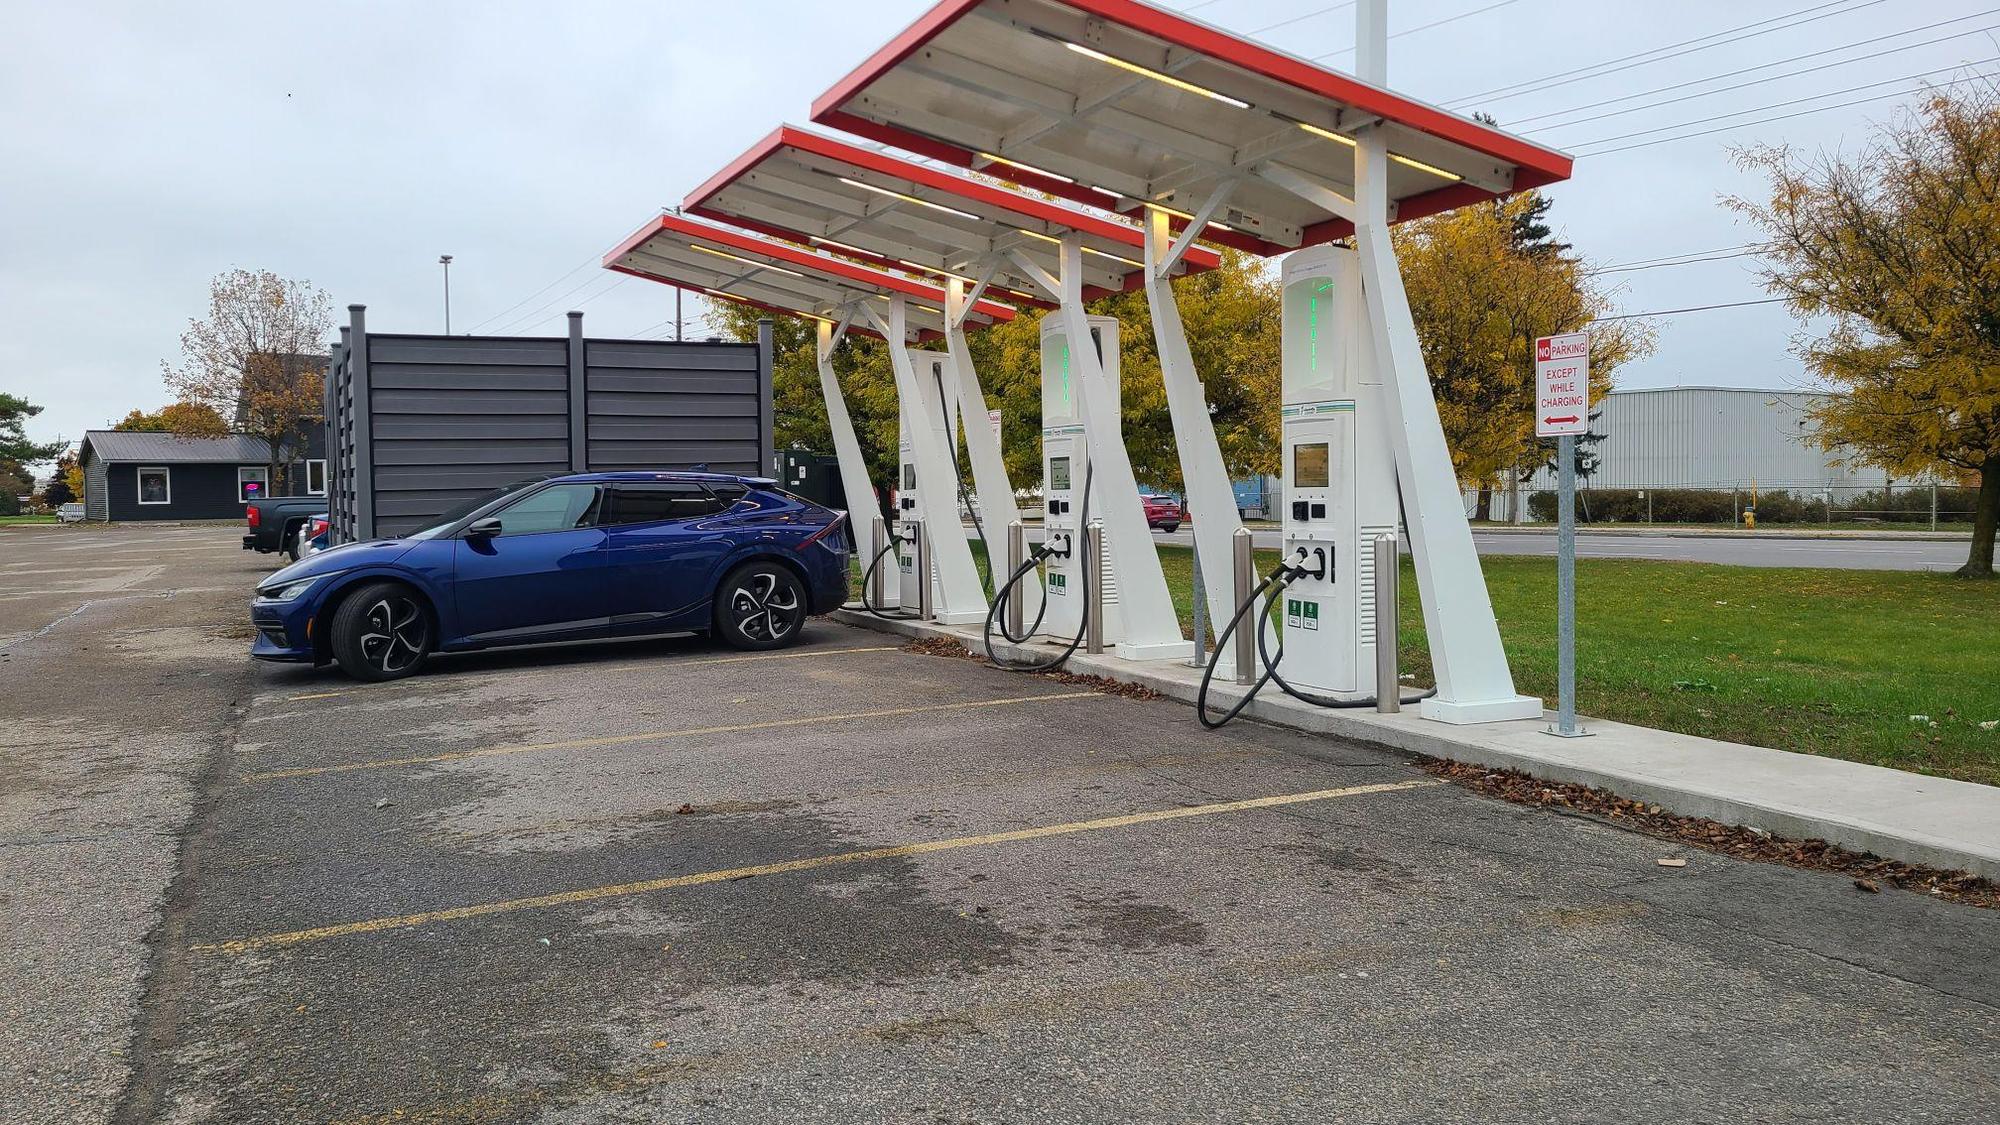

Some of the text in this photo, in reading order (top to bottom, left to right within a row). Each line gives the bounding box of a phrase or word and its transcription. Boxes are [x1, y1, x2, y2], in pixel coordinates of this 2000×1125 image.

[1539, 343, 1585, 358] NO PARKING
[1546, 368, 1577, 379] EXCEPT
[1550, 382, 1575, 393] WHILE
[1541, 396, 1583, 408] CHARGING
